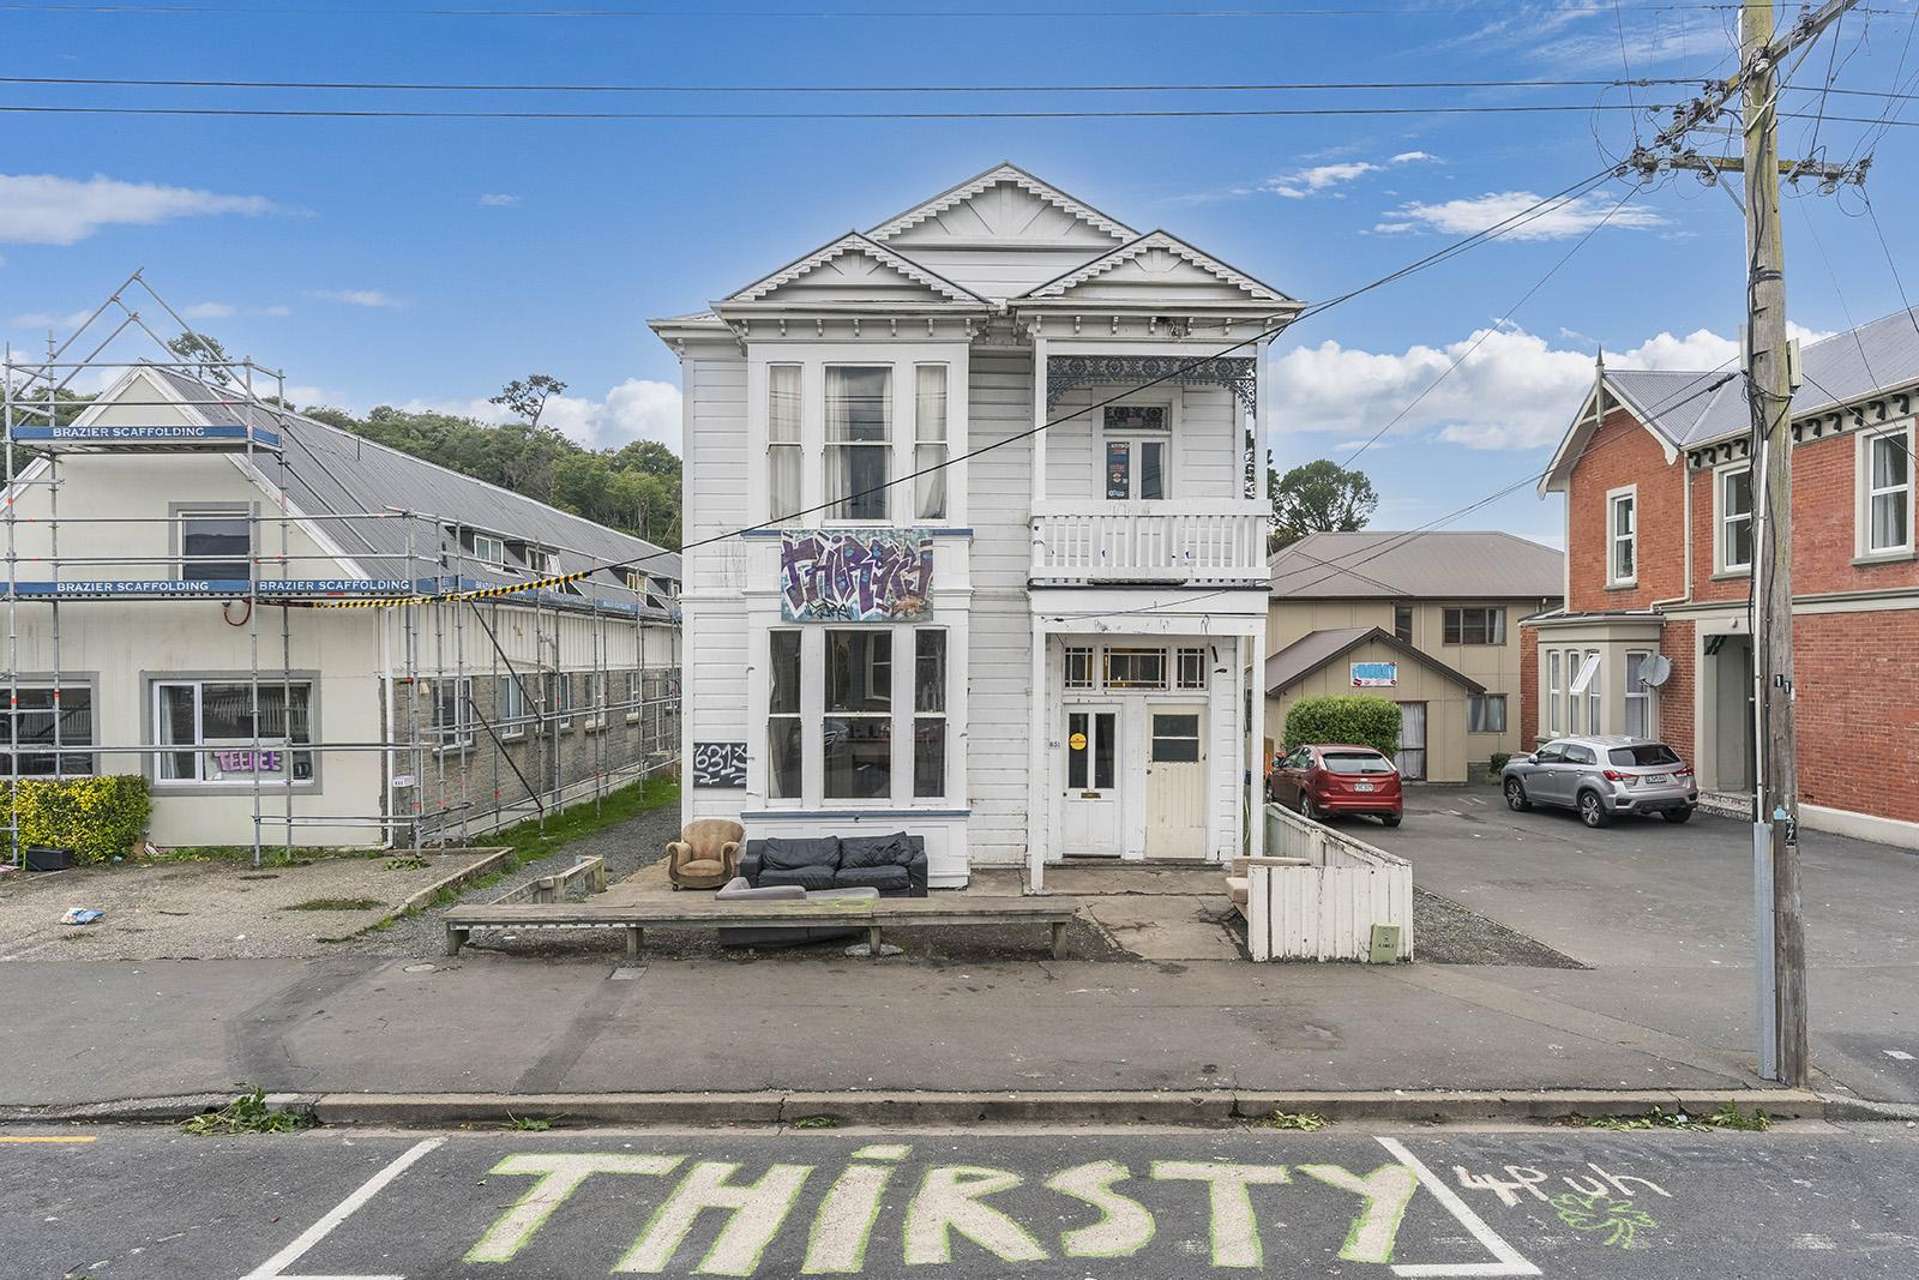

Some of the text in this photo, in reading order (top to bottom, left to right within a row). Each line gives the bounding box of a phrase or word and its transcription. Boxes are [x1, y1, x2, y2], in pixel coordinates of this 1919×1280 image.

[52, 427, 205, 438] BRAZIER SCAFFOLDING
[56, 581, 209, 592] BRAZIER SCAFFOLDING
[259, 580, 410, 591] BRAZIER SCAFFOLDING
